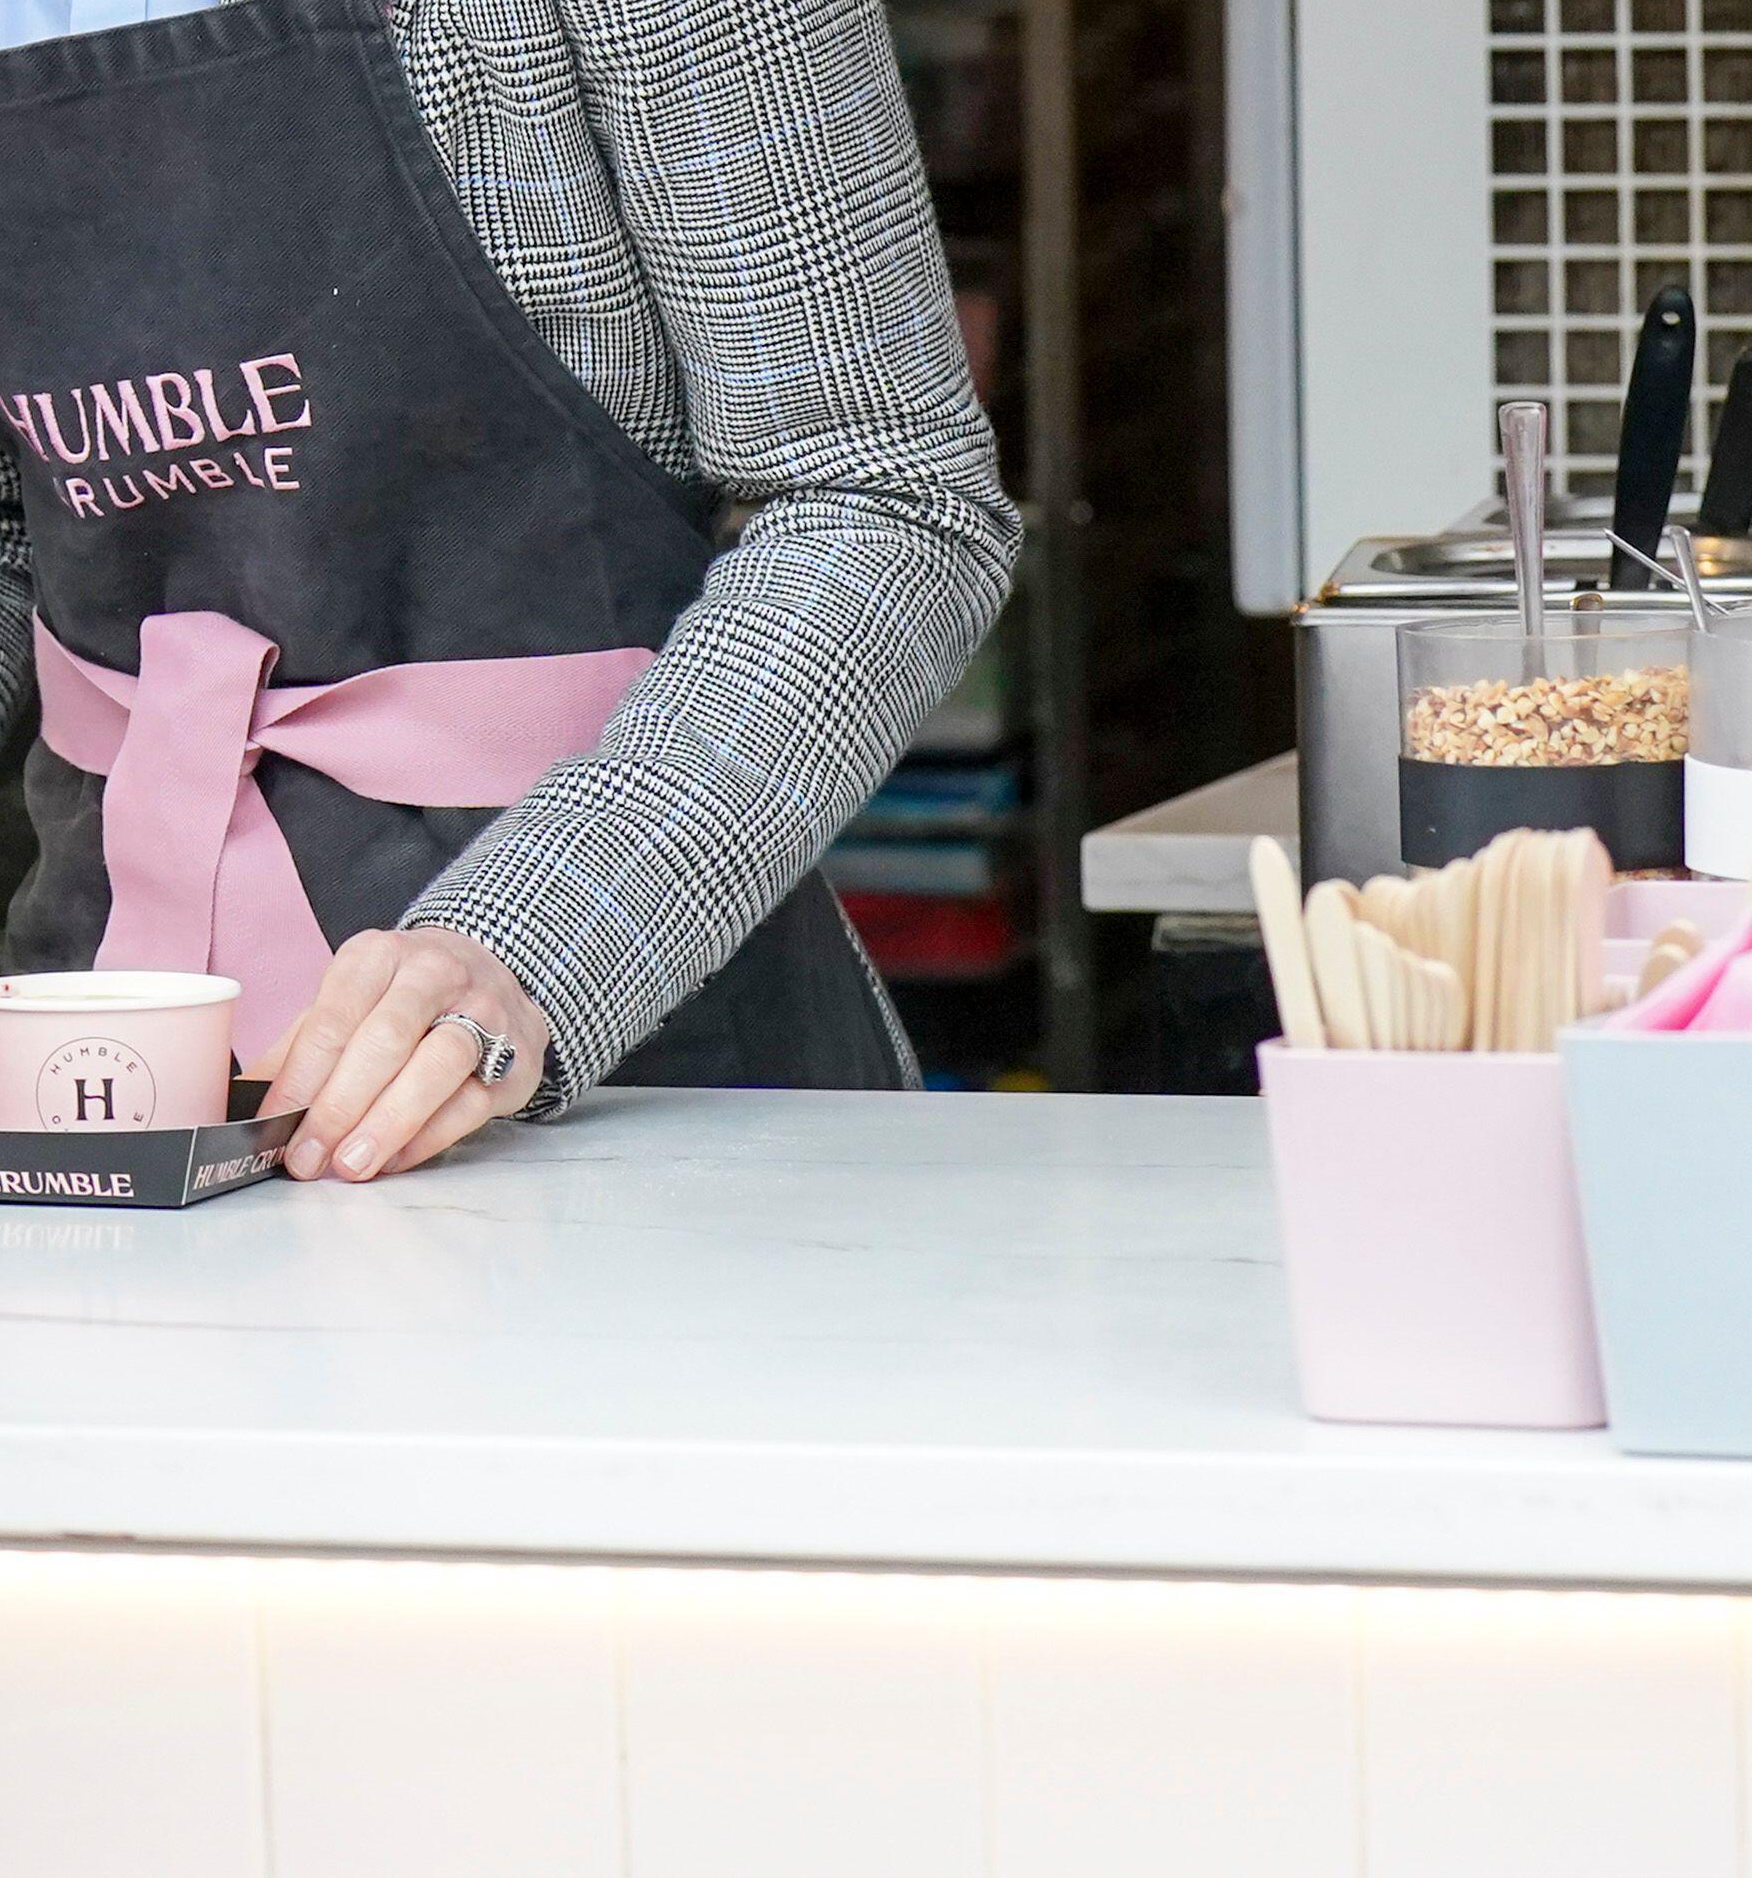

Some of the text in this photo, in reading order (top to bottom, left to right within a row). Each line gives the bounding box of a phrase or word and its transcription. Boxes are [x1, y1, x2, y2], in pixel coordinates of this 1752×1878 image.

[49, 1046, 138, 1076] HUMBLE
[74, 1077, 116, 1122] H
[192, 1155, 255, 1190] HUMBLE
